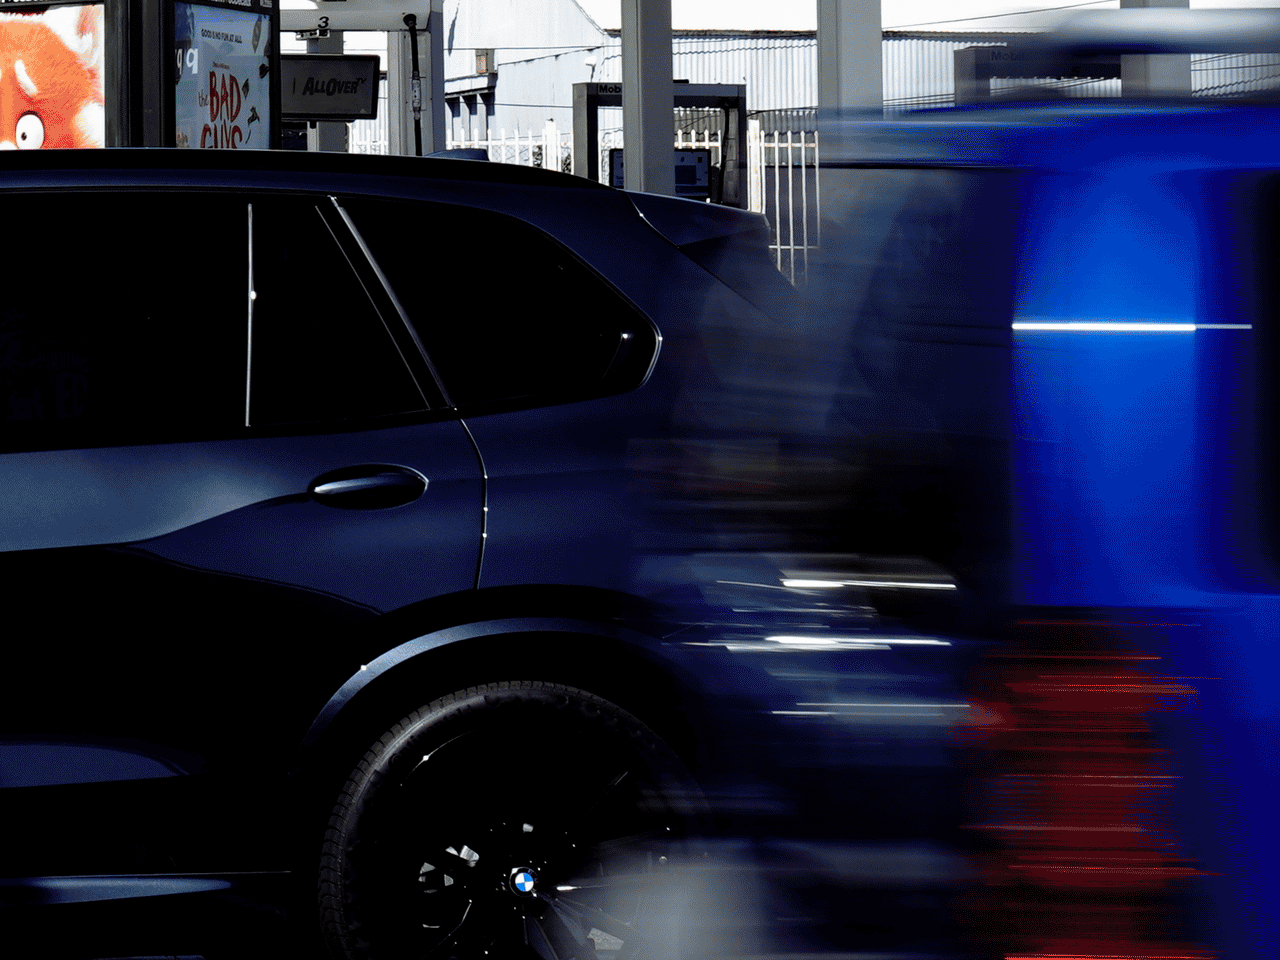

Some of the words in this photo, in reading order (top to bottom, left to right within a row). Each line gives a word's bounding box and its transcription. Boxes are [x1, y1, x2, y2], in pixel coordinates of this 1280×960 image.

[318, 16, 329, 29] 3
[599, 84, 622, 94] Mob
[209, 71, 242, 123] BAD
